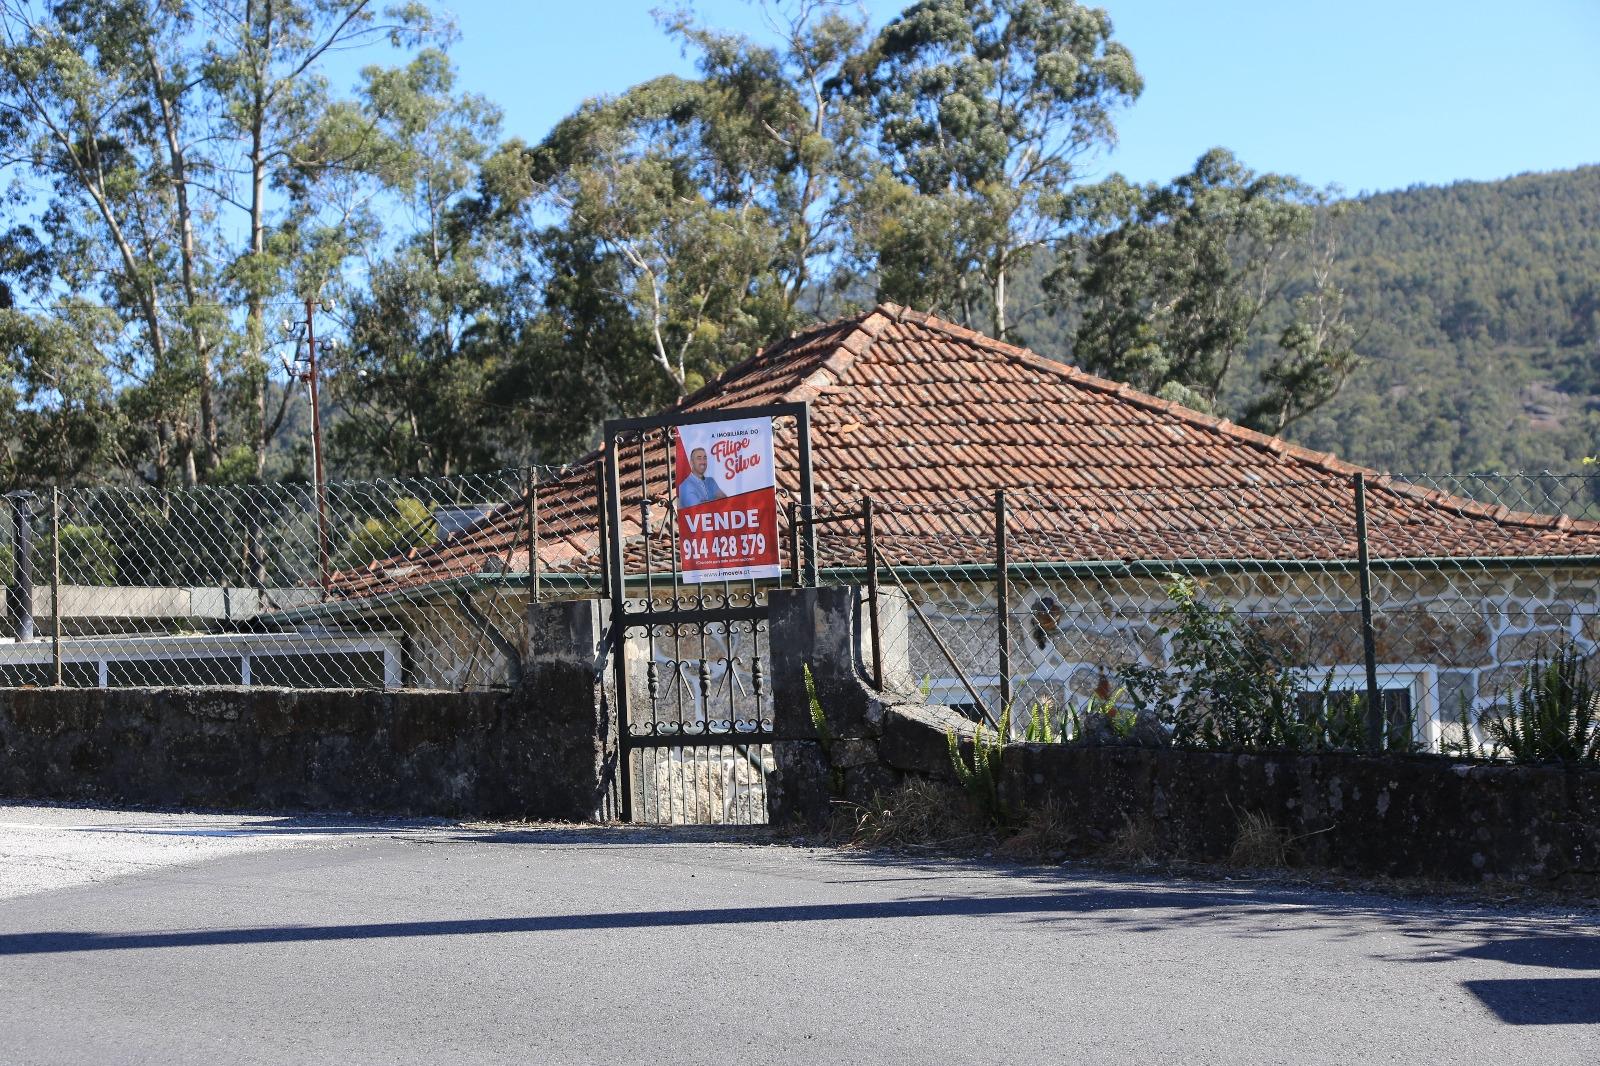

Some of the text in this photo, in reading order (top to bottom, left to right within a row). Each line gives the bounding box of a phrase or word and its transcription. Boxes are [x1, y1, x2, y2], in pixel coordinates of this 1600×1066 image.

[711, 438, 750, 462] Filipe
[724, 454, 760, 480] Silva
[685, 509, 760, 533] VENDE
[683, 533, 766, 560] 914 428 379
